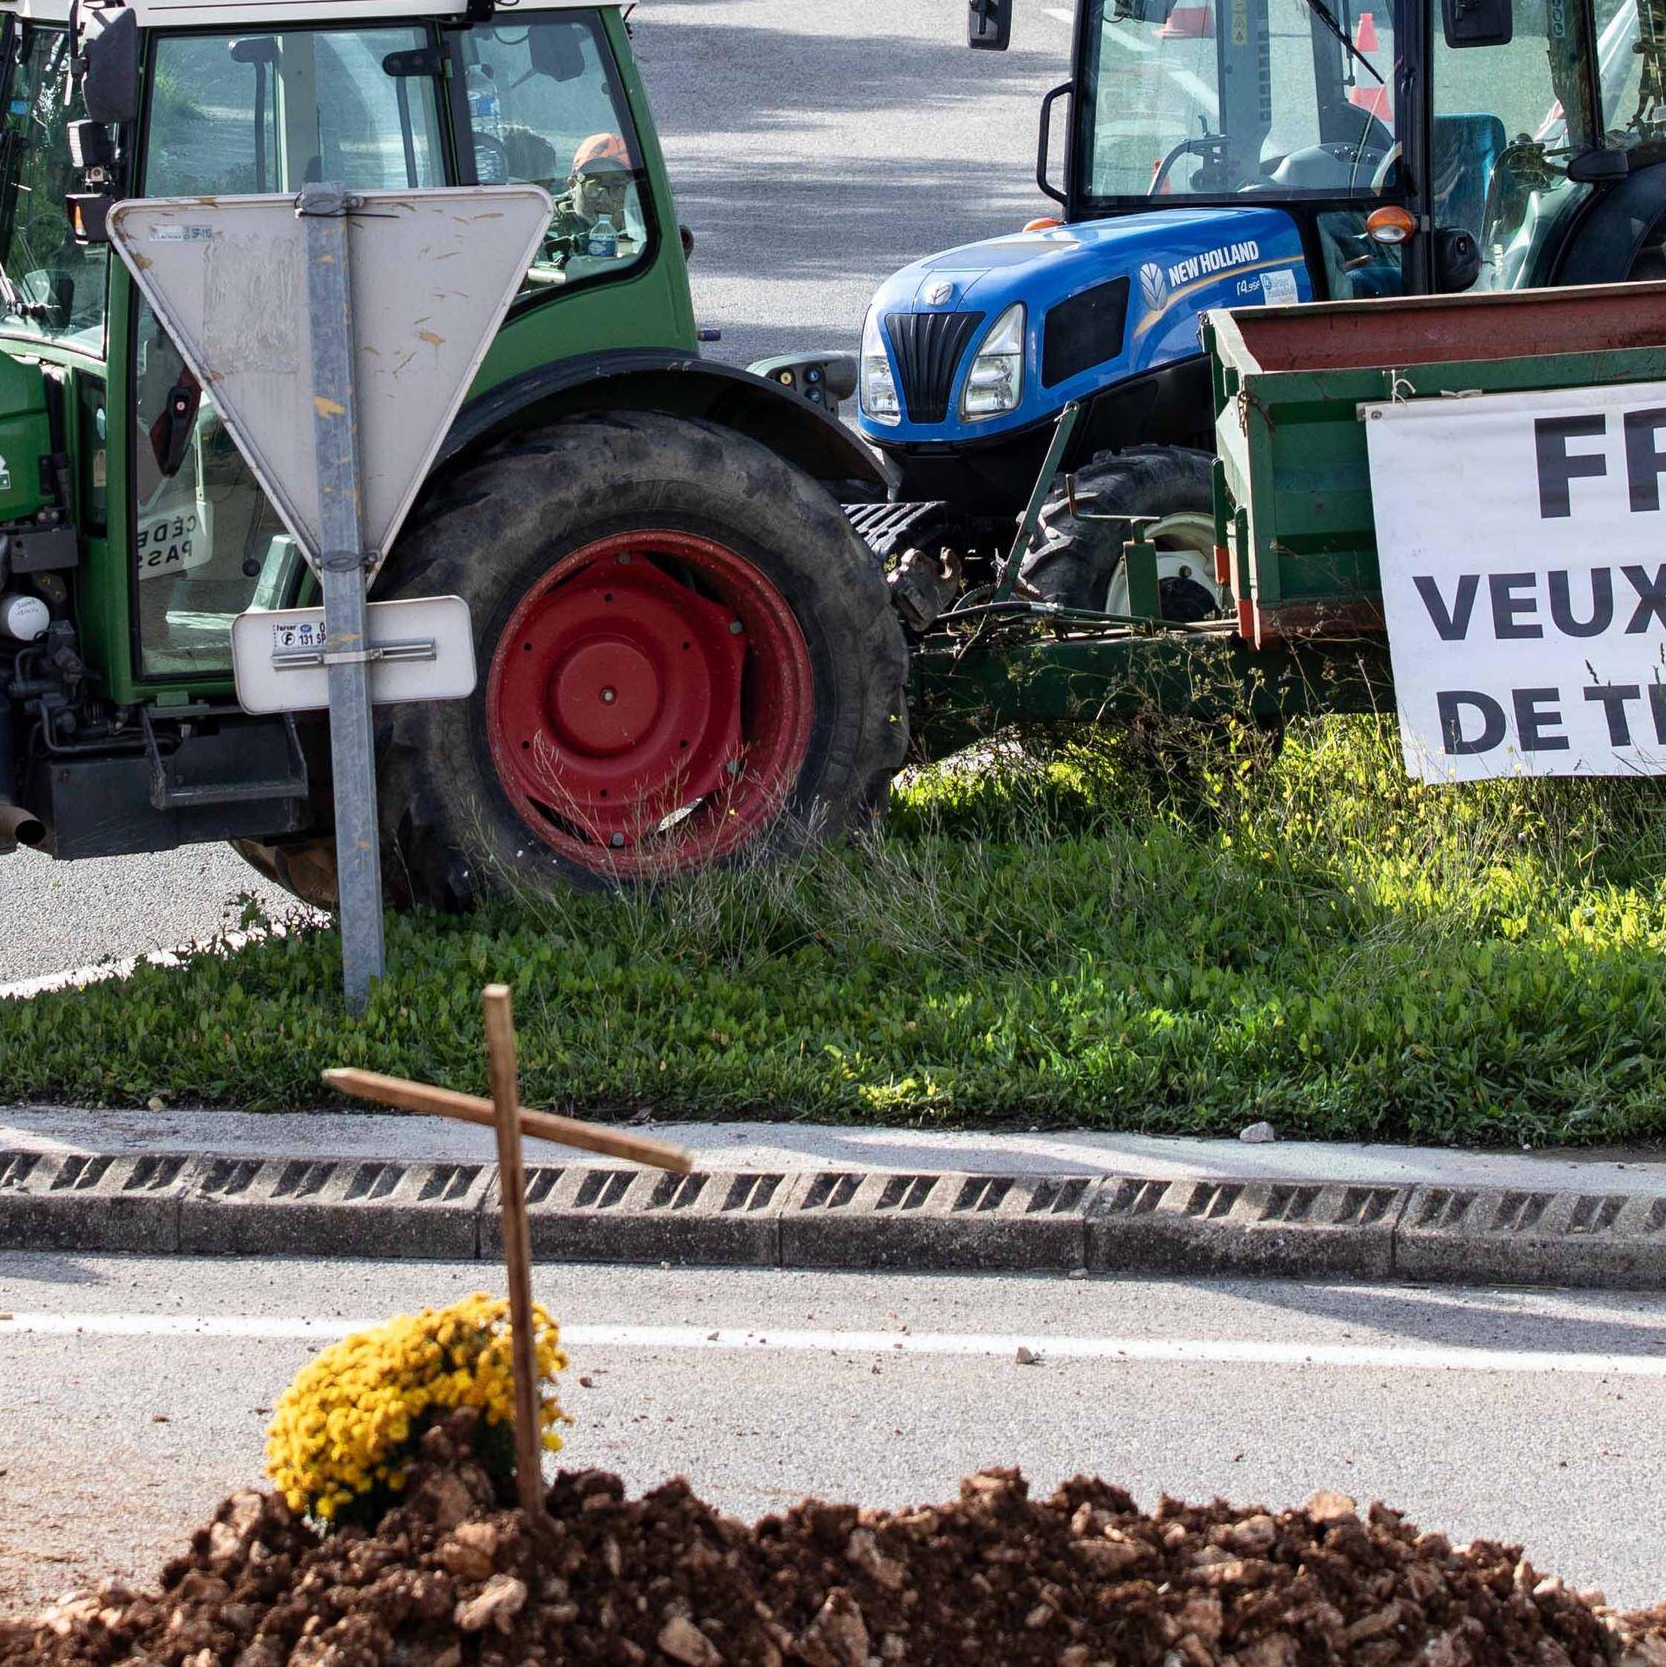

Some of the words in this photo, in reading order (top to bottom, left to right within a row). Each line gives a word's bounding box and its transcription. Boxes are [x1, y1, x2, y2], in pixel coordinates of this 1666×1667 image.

[1168, 257, 1200, 287] NEW
[1200, 240, 1259, 273] HOLLAND
[1436, 687, 1569, 755] DE
